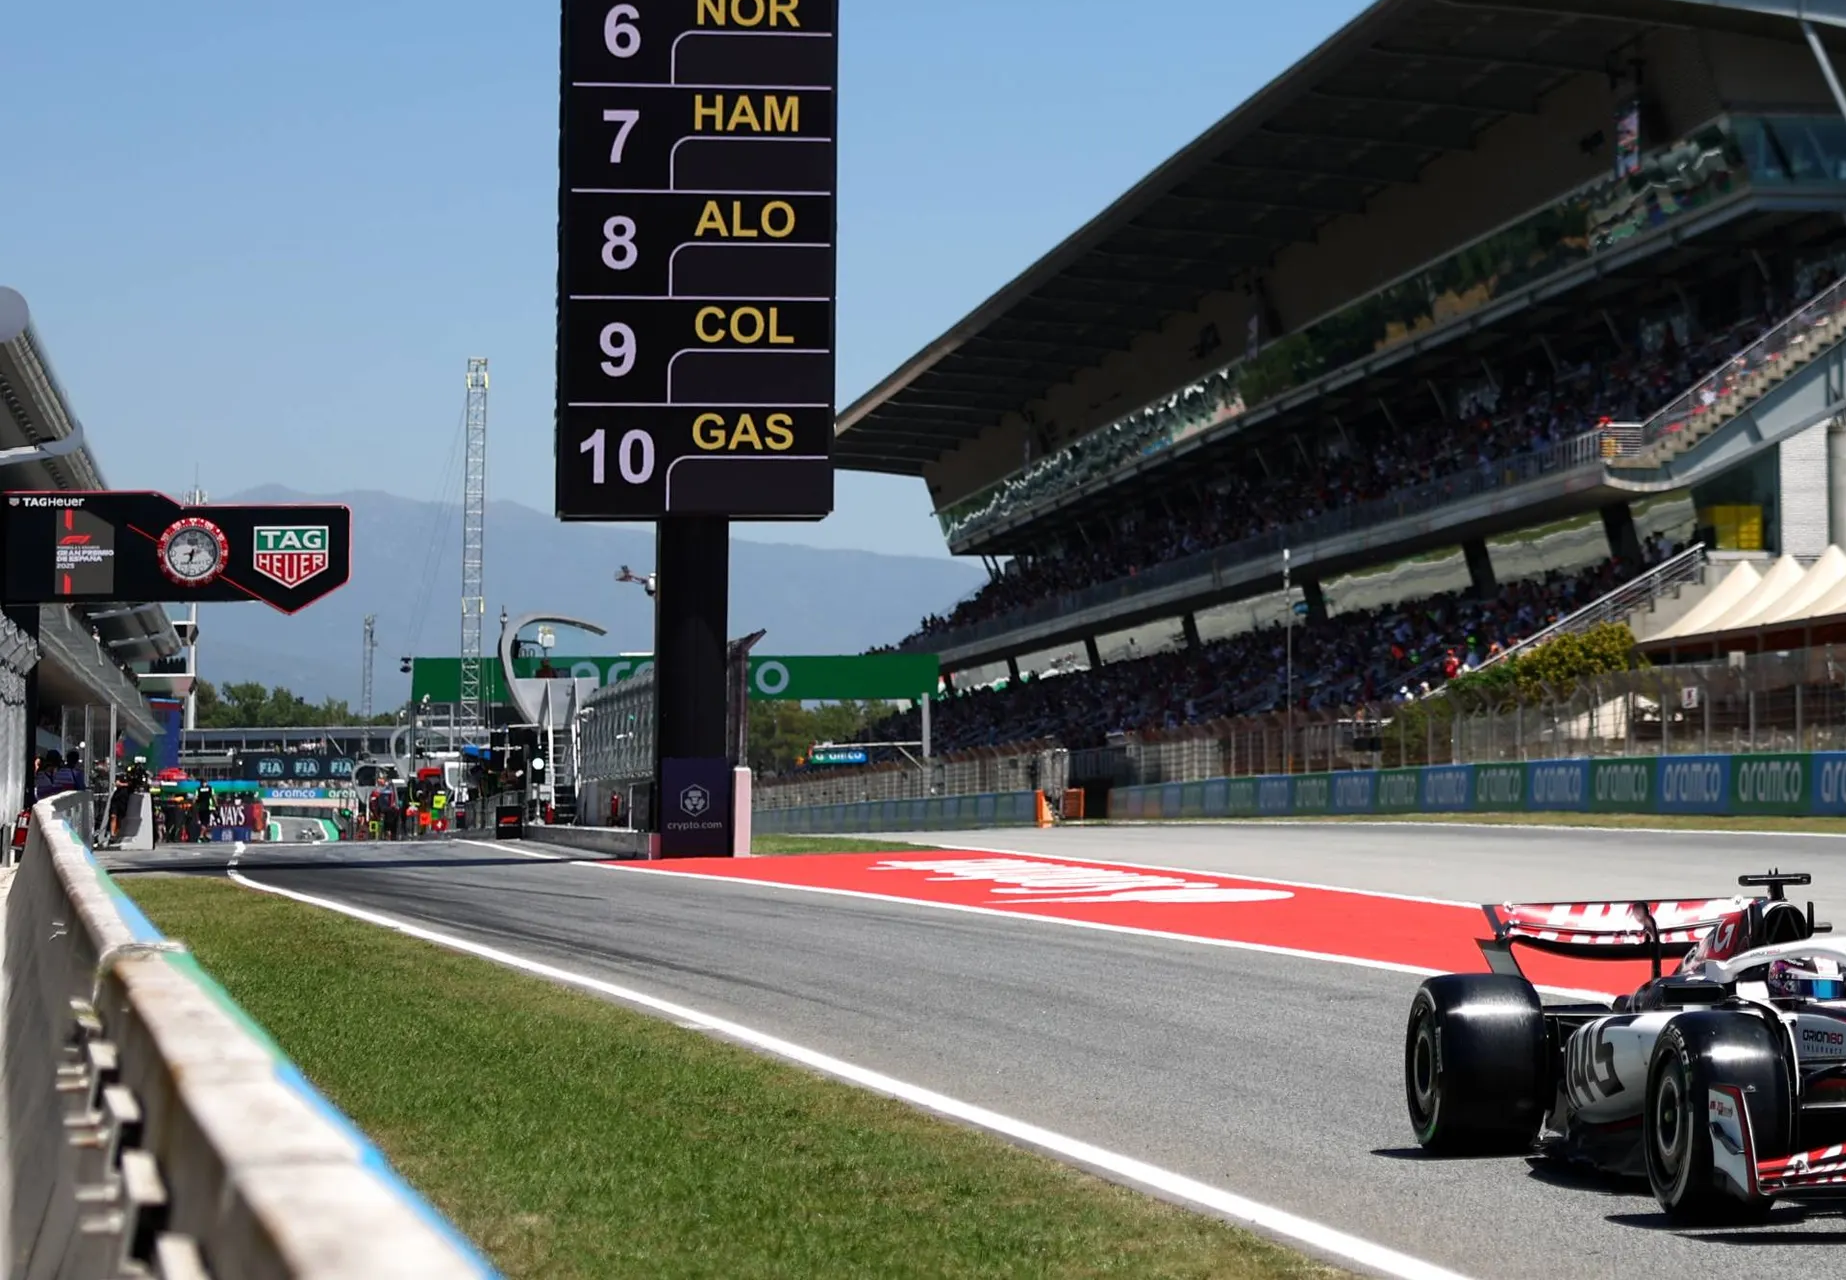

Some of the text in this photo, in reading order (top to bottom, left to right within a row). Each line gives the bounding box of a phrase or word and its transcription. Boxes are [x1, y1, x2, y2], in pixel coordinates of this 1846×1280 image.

[604, 4, 640, 57] 6
[604, 95, 798, 163] 7 HAM
[602, 201, 795, 269] 8 ALO
[600, 307, 794, 376] 9 COL
[581, 413, 793, 484] 10 GAS
[260, 531, 322, 549] TAG
[258, 554, 324, 584] HEUER
[259, 761, 283, 774] FIA
[294, 761, 319, 774] FIA
[1662, 763, 1721, 802] aramco
[1738, 761, 1802, 804] aramco
[272, 789, 316, 798] aramco
[667, 821, 723, 831] crypto.com
